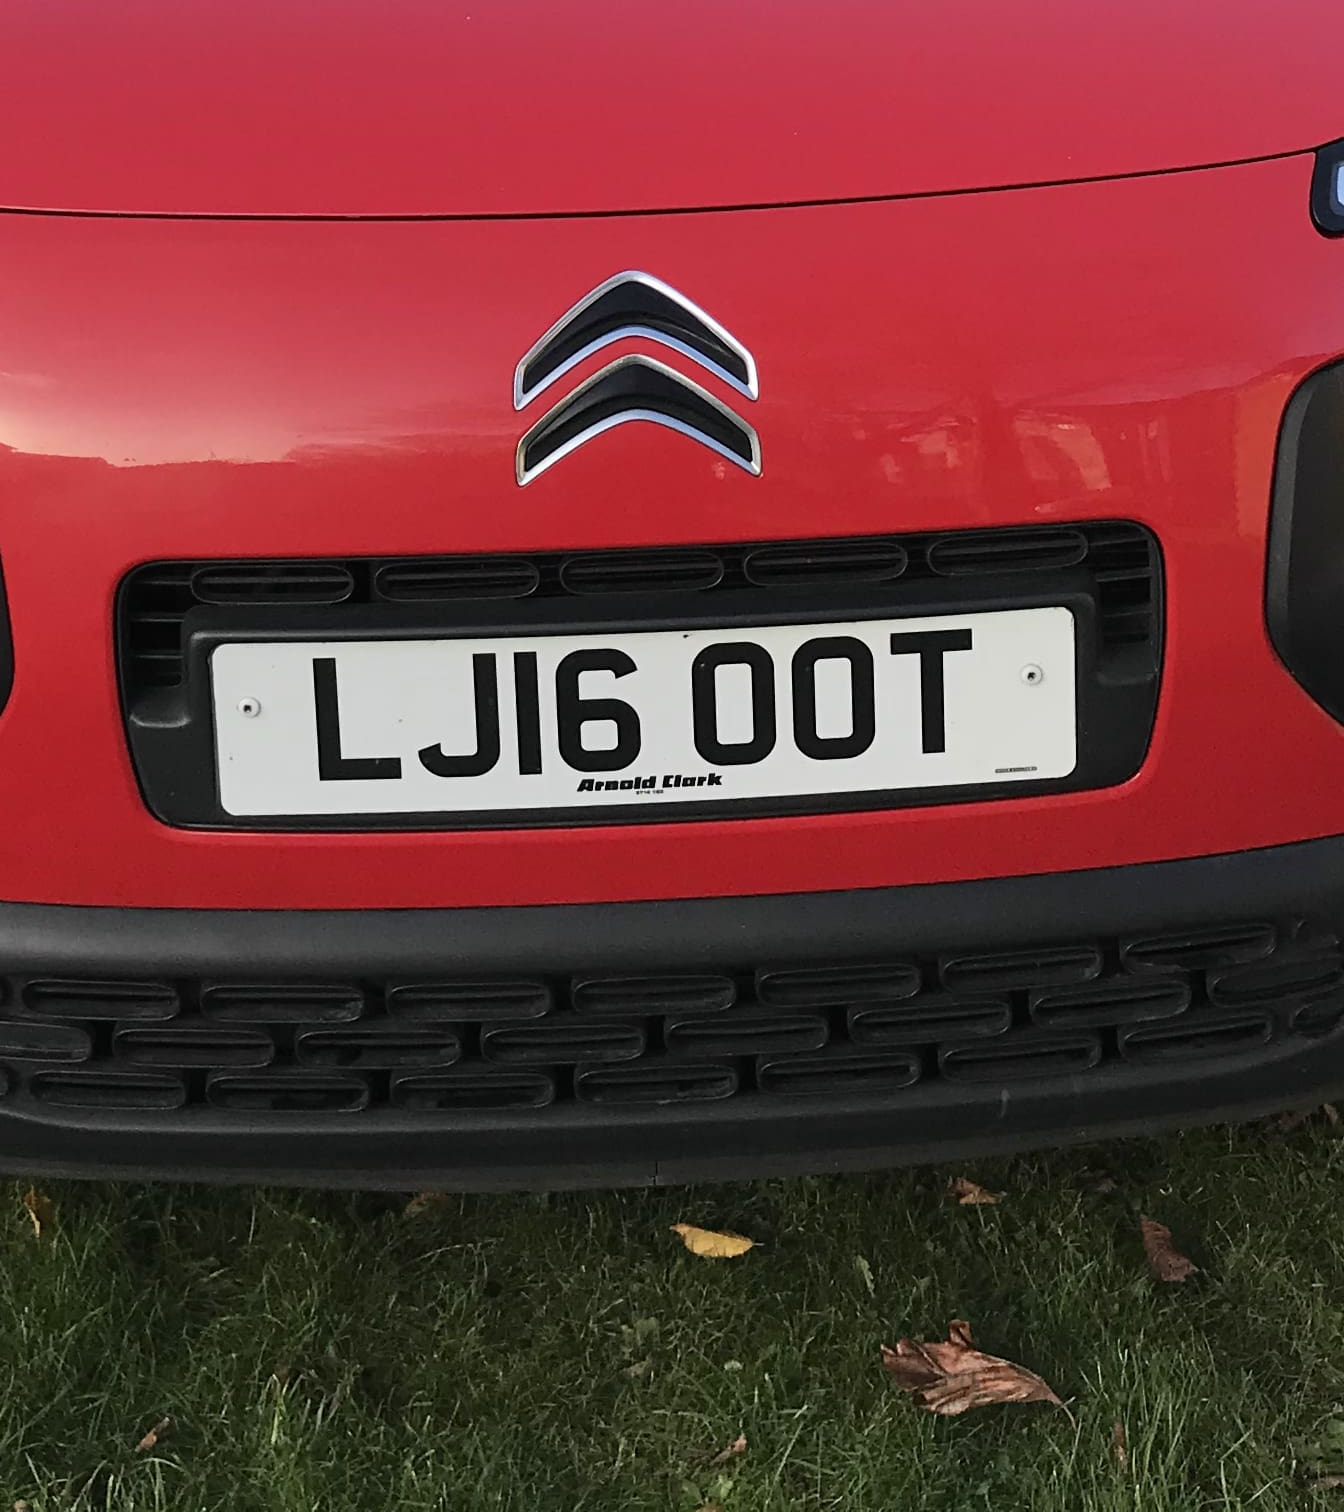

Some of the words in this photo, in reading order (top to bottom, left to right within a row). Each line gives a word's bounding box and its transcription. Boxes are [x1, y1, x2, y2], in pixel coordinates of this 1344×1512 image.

[313, 649, 641, 781] LJ16
[577, 775, 657, 792] Arnold
[662, 773, 723, 788] Clark
